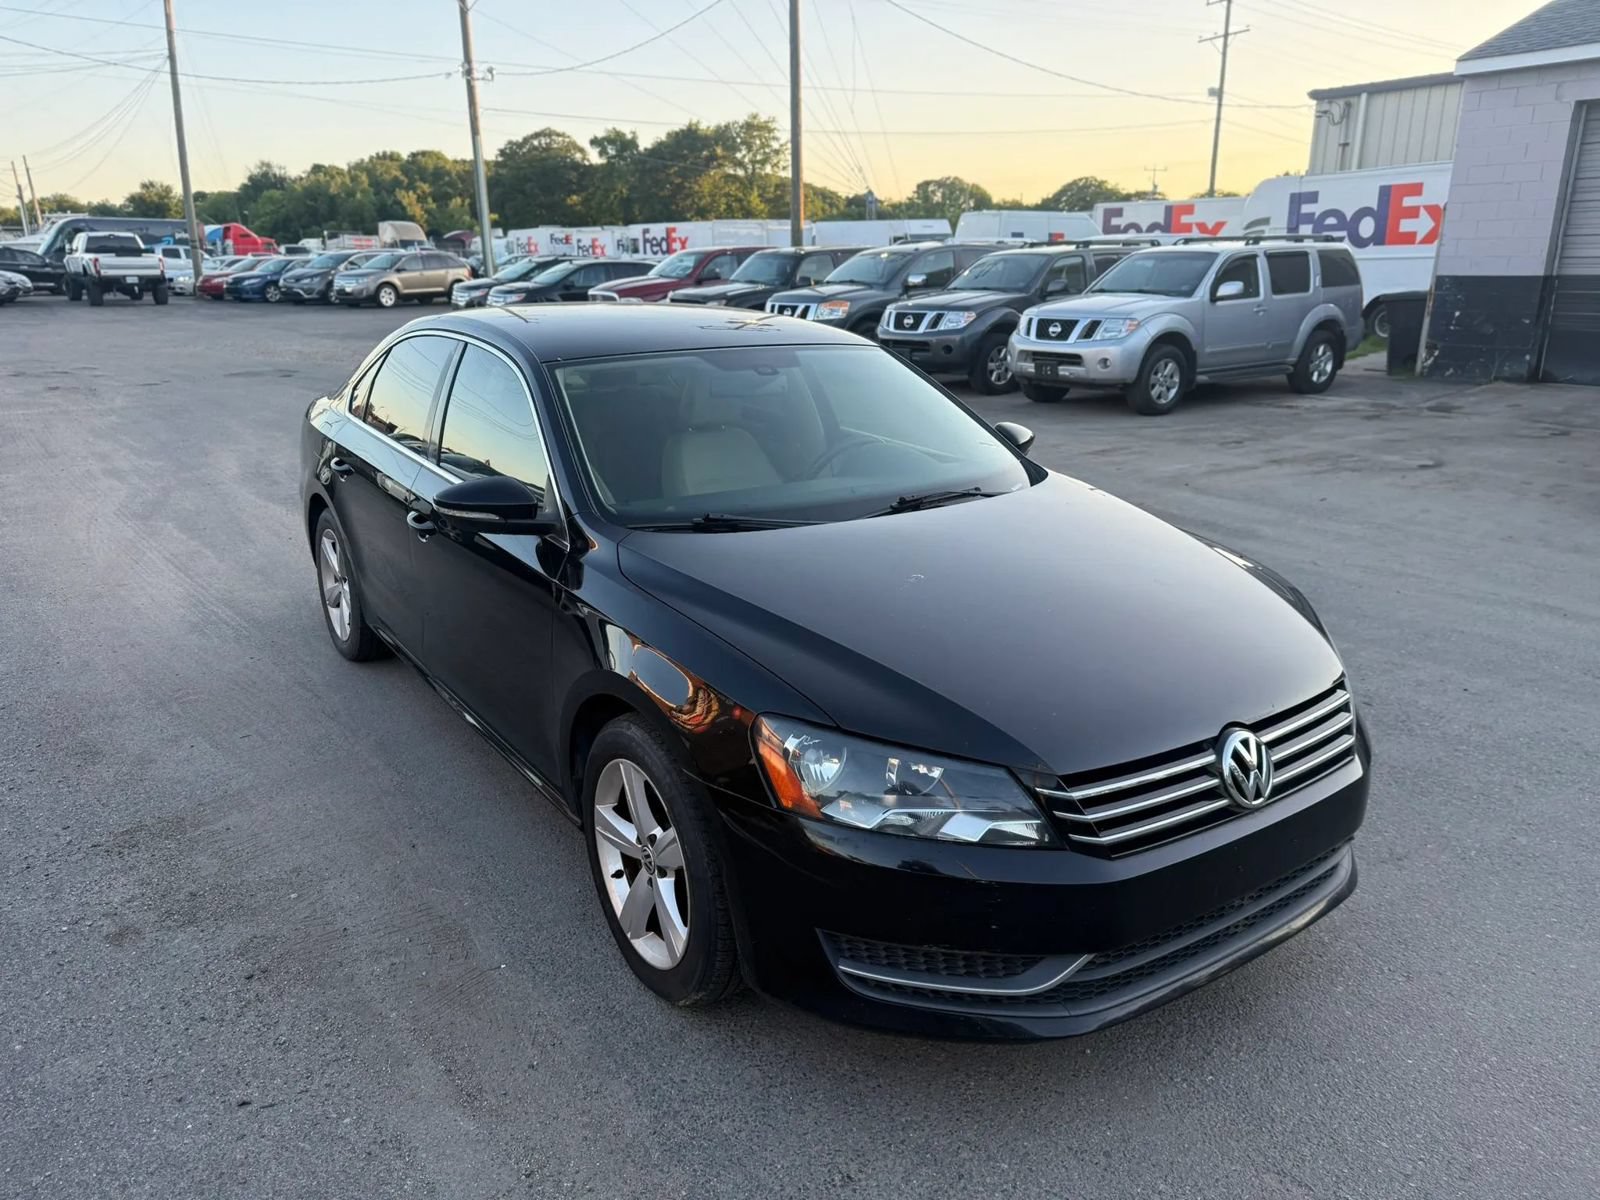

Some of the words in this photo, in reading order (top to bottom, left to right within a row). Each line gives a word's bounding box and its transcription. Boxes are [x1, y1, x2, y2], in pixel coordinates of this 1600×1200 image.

[1287, 182, 1444, 249] FedEx
[516, 236, 539, 255] FedEx
[550, 233, 573, 246] FedE
[577, 237, 606, 256] FedEx
[642, 227, 689, 255] FedEx
